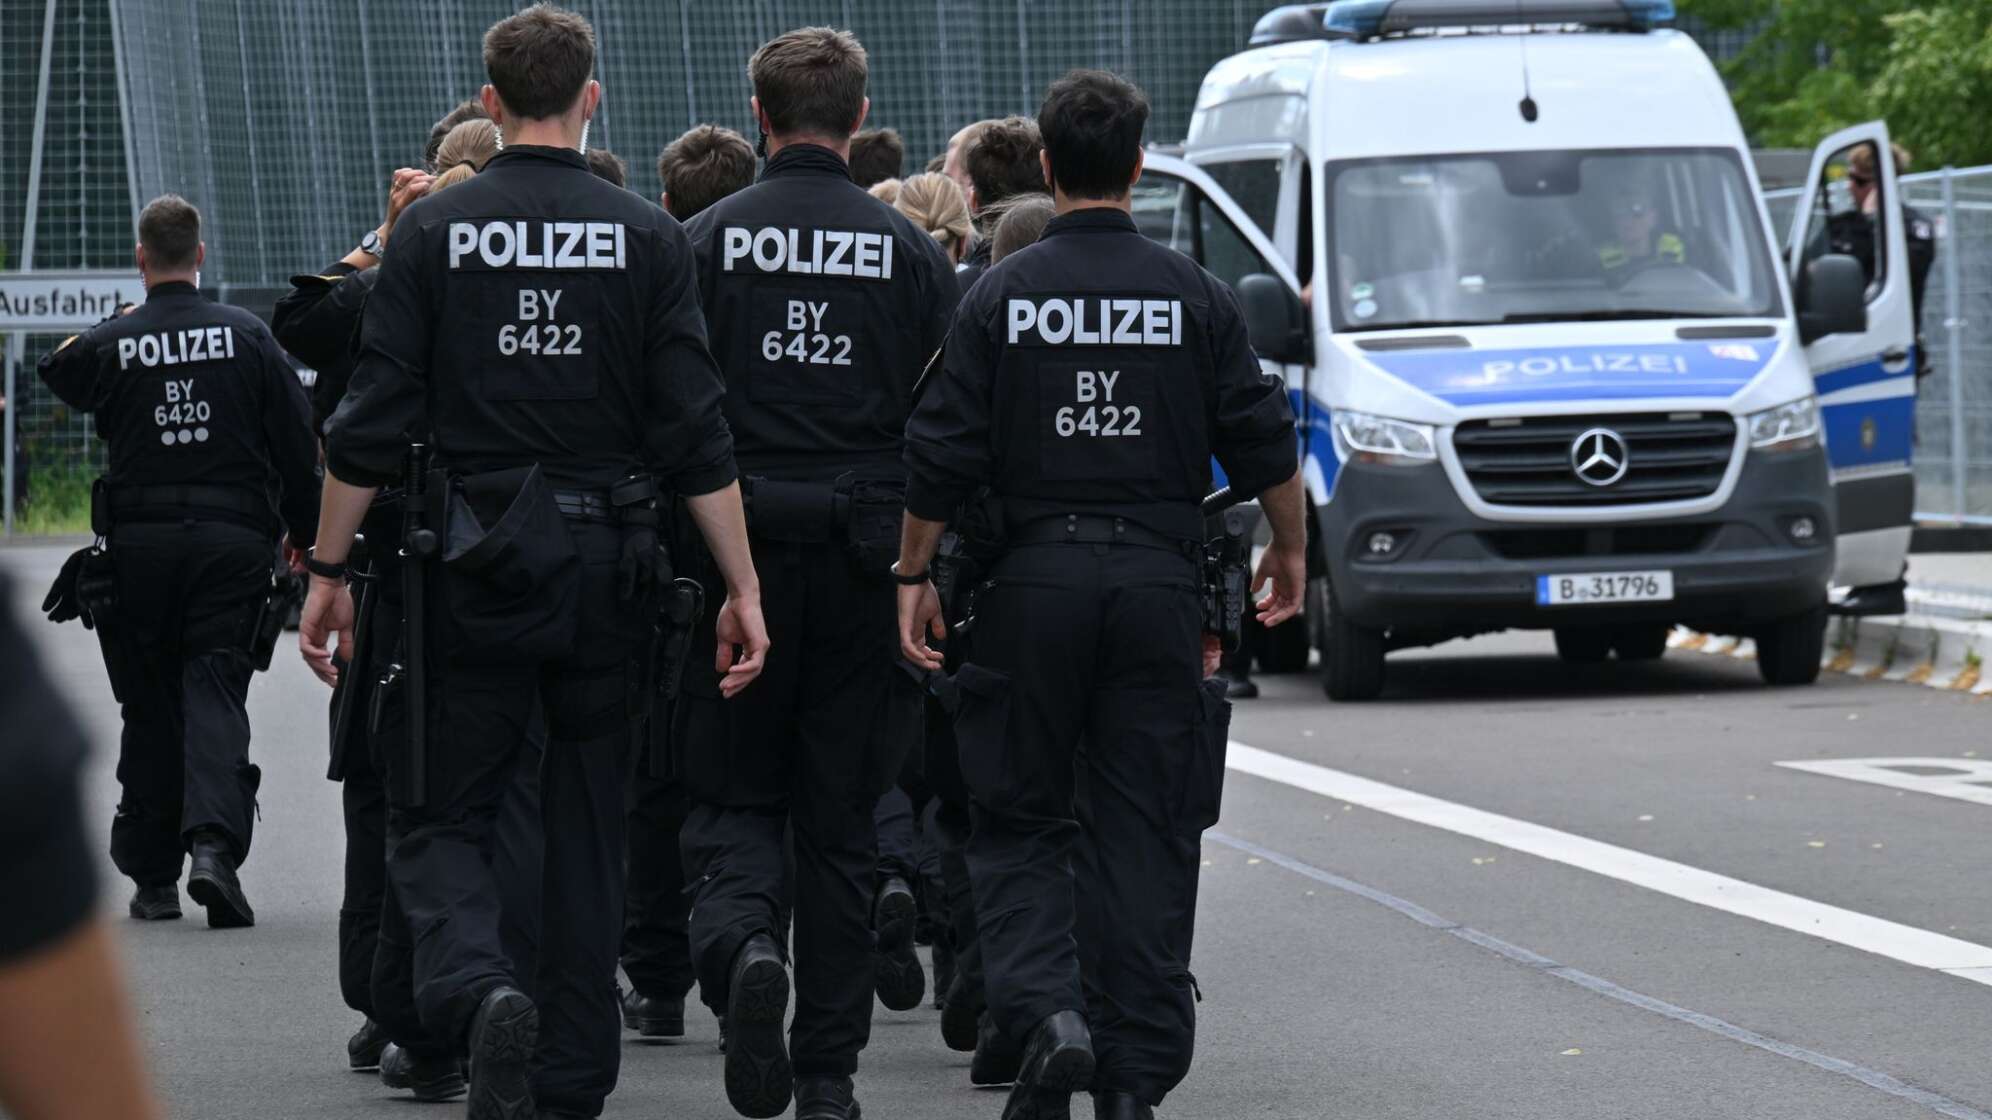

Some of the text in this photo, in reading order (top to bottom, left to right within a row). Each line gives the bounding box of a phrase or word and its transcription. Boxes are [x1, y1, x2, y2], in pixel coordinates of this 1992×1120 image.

[448, 221, 626, 270] POLIZEI
[722, 226, 892, 280] POLIZEI
[0, 287, 122, 316] Ausfahrt
[518, 289, 562, 322] BY
[786, 300, 829, 333] BY
[1008, 298, 1181, 345] POLIZEI
[117, 326, 235, 370] POLIZEI
[498, 323, 582, 355] 6422
[762, 331, 852, 366] 6422
[1076, 370, 1120, 402] BY
[1482, 353, 1689, 386] POLIZEI
[165, 379, 194, 402] BY
[154, 400, 211, 427] 6420
[1055, 405, 1142, 437] 6422
[1560, 575, 1660, 600] B 31796
